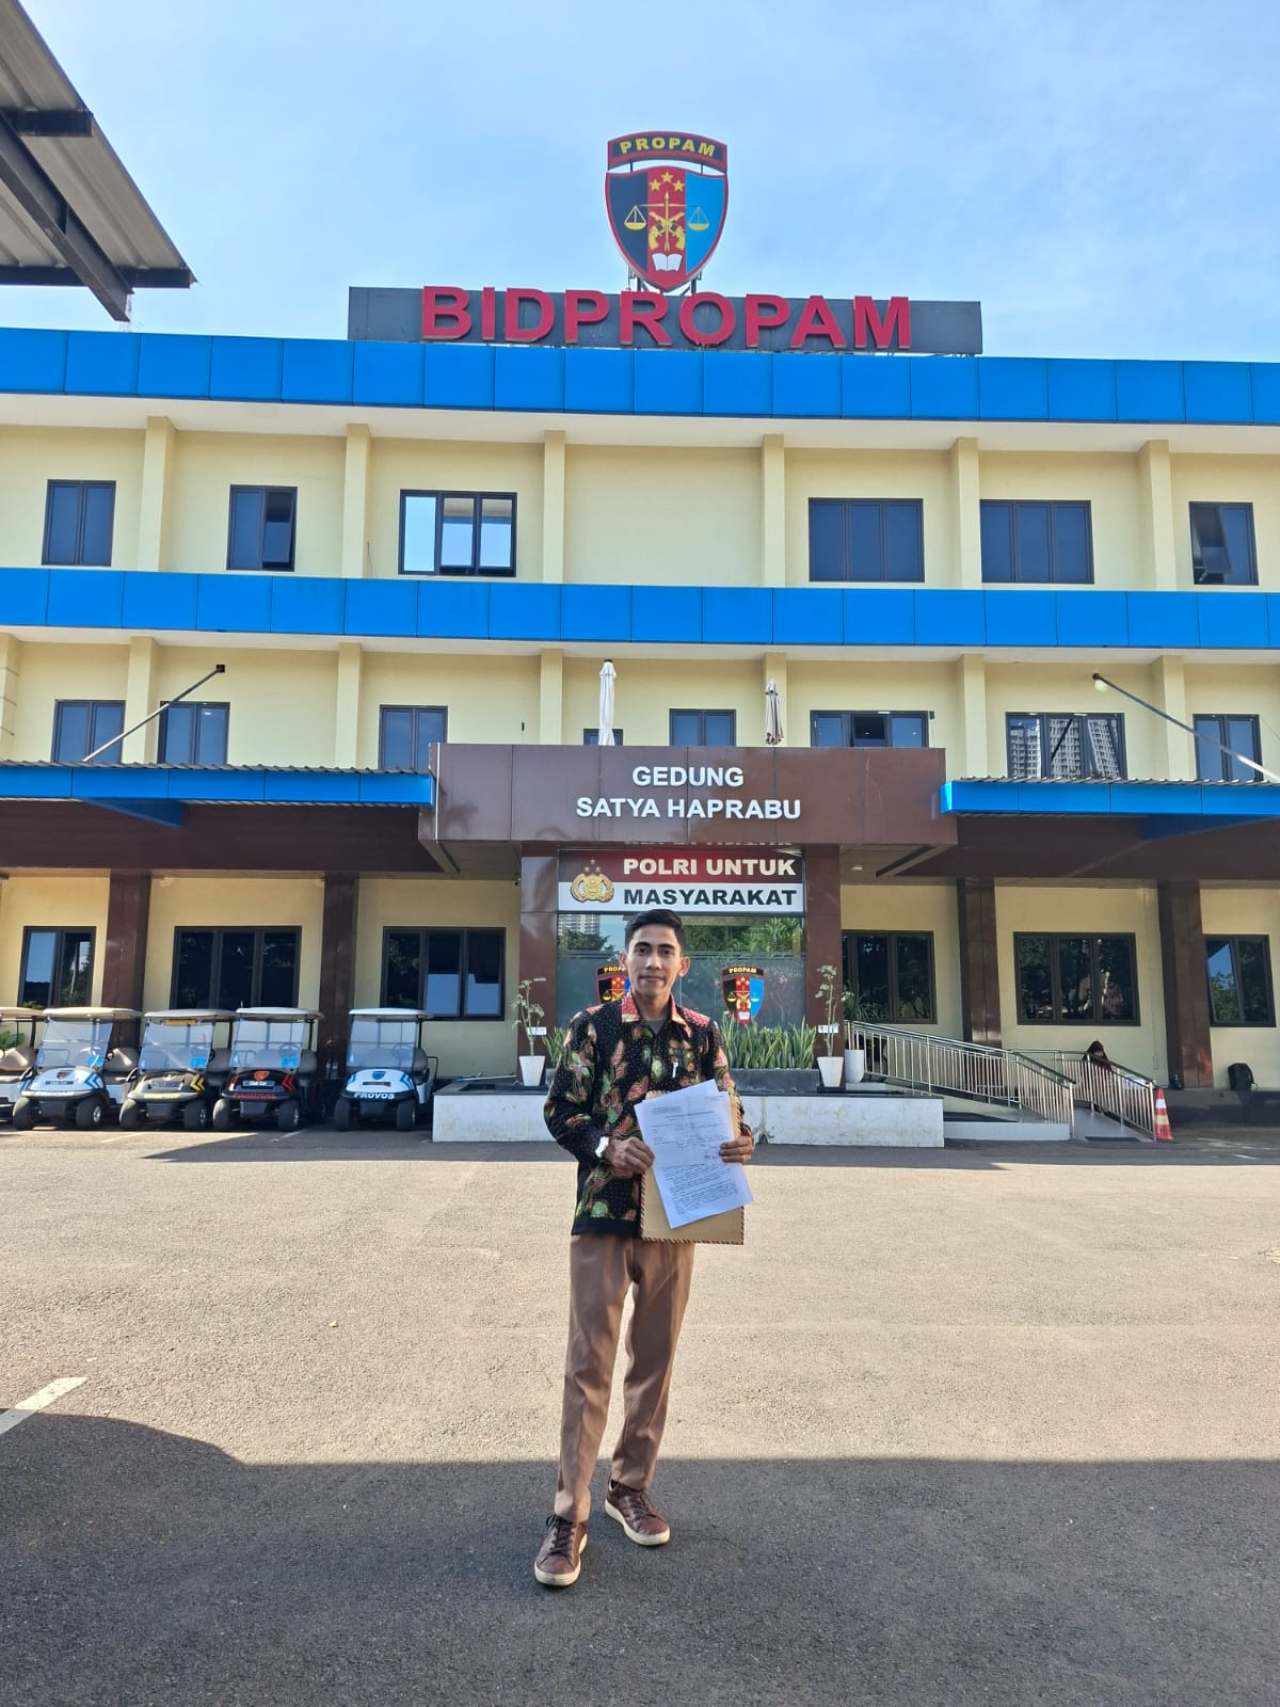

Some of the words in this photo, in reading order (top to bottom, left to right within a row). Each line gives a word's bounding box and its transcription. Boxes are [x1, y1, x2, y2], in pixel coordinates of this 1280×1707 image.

[619, 136, 715, 157] PROPAM
[421, 285, 910, 350] BIDPROPAM
[632, 766, 744, 787] GEDUNG
[576, 797, 661, 817] SATYA
[667, 798, 801, 819] HAPRABU
[623, 858, 698, 876] POLRI
[706, 858, 796, 876] UNTUK
[623, 889, 797, 906] MASYARAKAT
[729, 966, 757, 974] PROPAM
[353, 1092, 395, 1100] PROVOS
